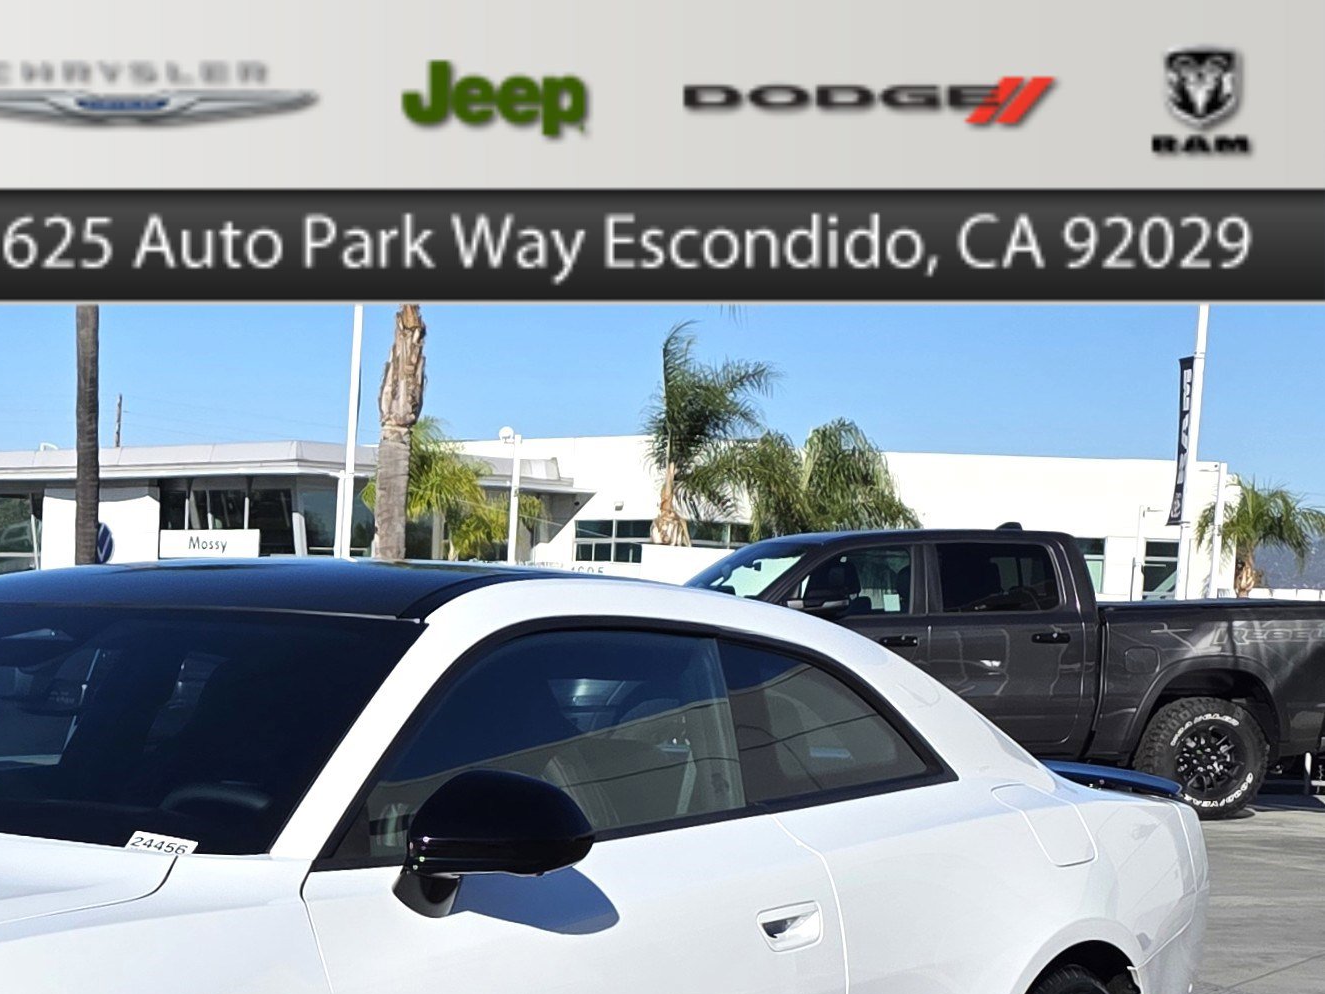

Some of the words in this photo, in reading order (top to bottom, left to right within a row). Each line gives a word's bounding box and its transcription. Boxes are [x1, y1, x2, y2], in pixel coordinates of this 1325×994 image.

[1176, 368, 1193, 485] RAM
[189, 536, 227, 553] Mossy
[130, 836, 188, 855] 24456
